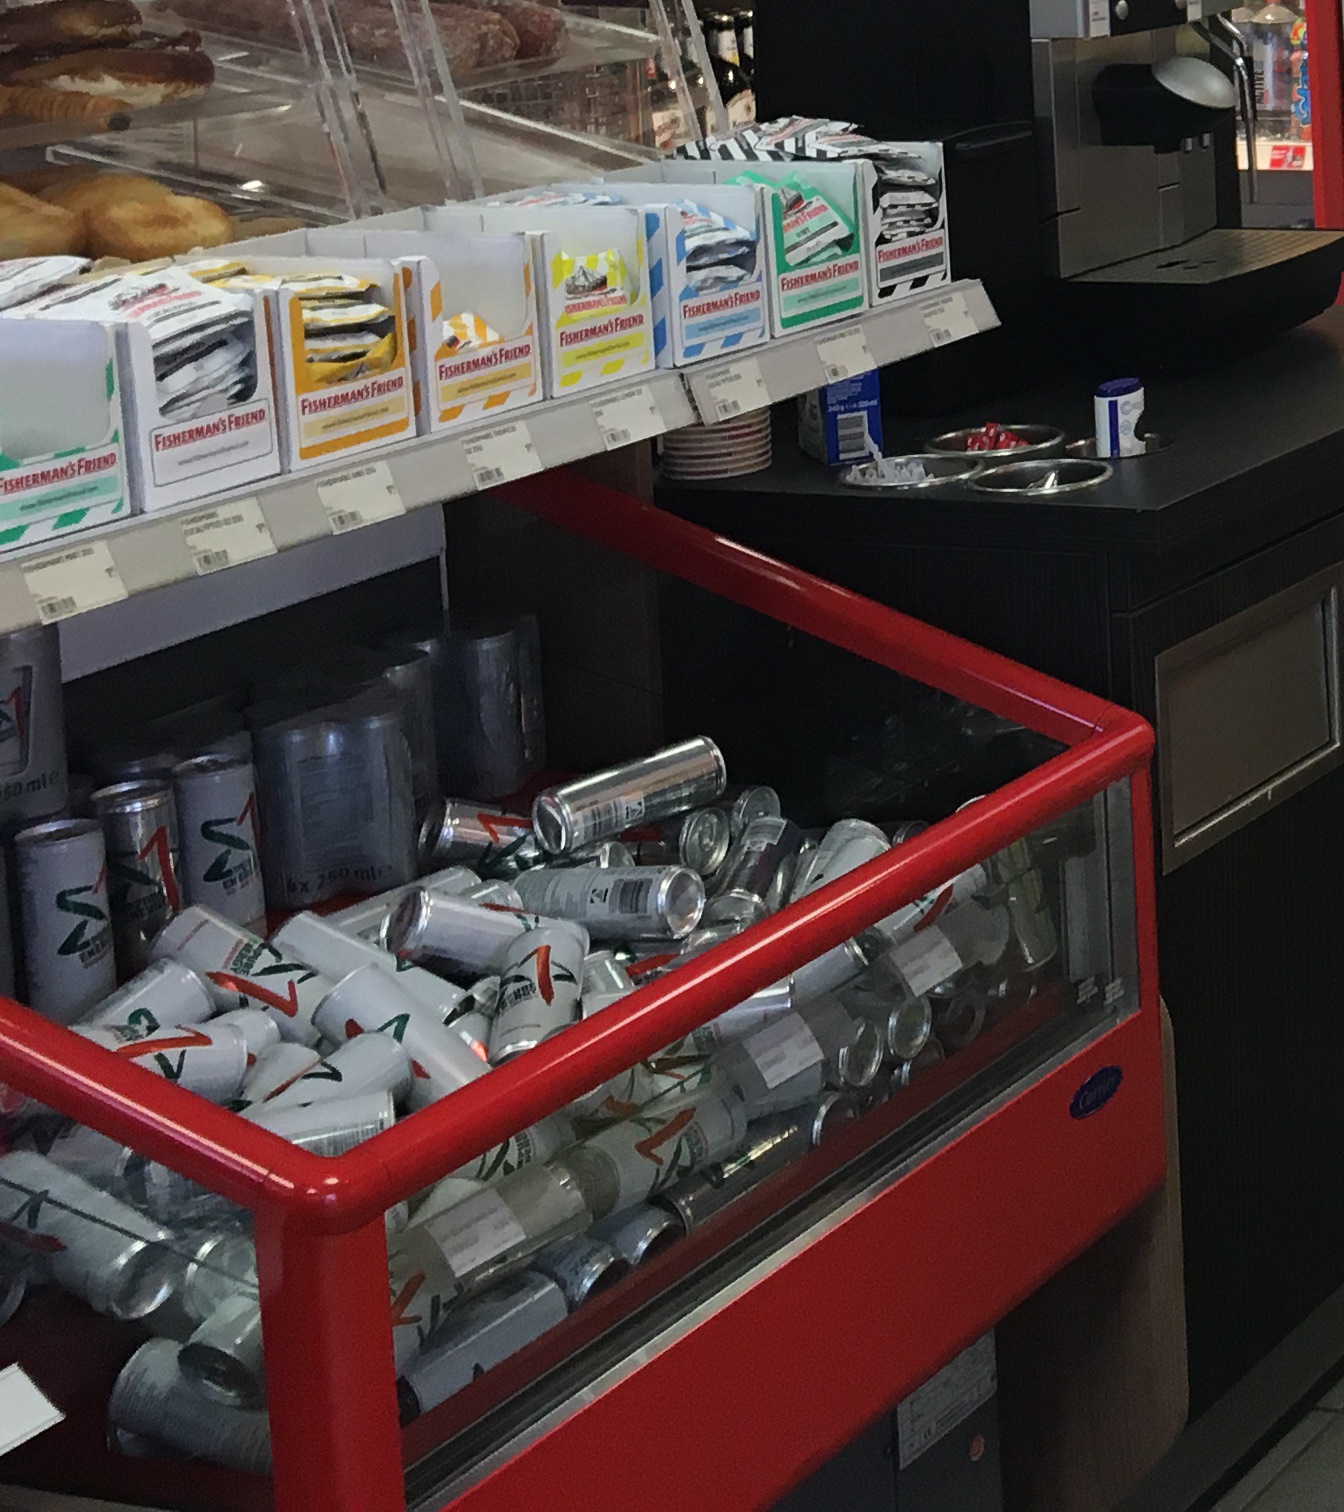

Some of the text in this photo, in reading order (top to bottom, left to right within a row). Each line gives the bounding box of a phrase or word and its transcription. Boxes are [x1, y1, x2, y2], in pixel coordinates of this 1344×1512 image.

[615, 314, 644, 333] FRIEND
[500, 343, 531, 364] FRIEND
[227, 407, 266, 432] FRIEND
